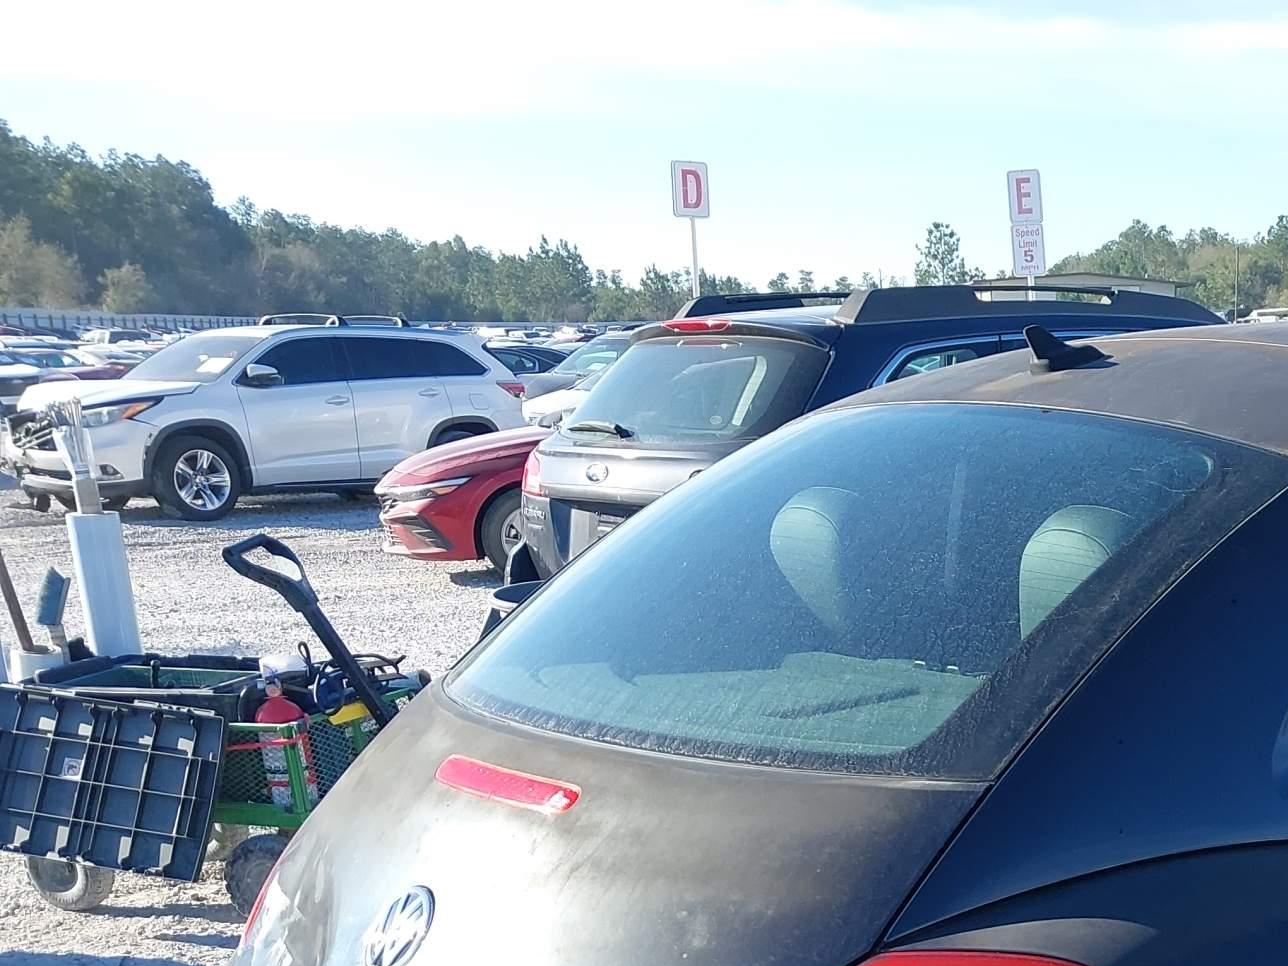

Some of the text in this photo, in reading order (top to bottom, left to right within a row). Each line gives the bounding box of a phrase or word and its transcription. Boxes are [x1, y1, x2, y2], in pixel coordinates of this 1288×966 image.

[681, 168, 703, 209] D
[1016, 178, 1032, 214] E
[1015, 228, 1040, 238] Speed
[1018, 239, 1038, 249] Limit
[1023, 249, 1034, 263] 5
